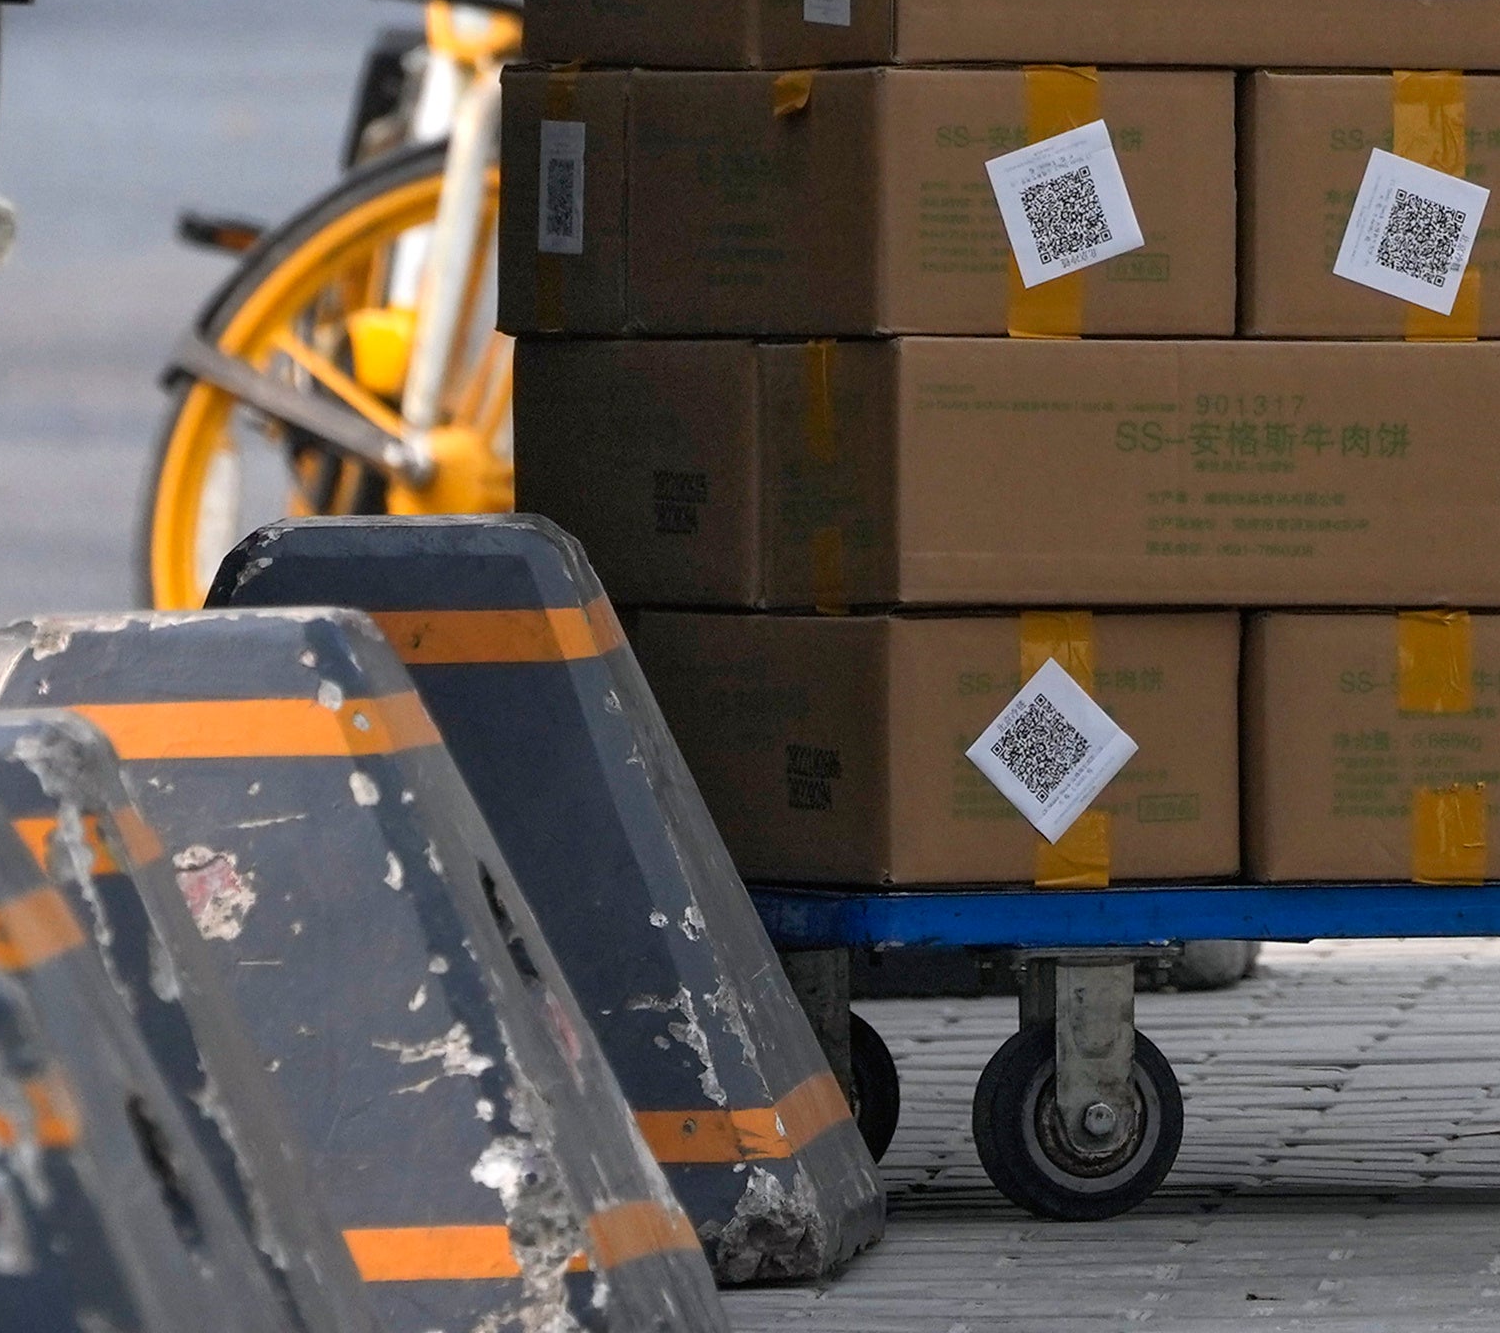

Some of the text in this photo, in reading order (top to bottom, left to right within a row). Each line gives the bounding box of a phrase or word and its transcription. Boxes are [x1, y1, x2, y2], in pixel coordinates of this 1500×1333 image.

[1194, 394, 1308, 418] 901317
[1115, 419, 1412, 459] SS-安格斯牛肉饼
